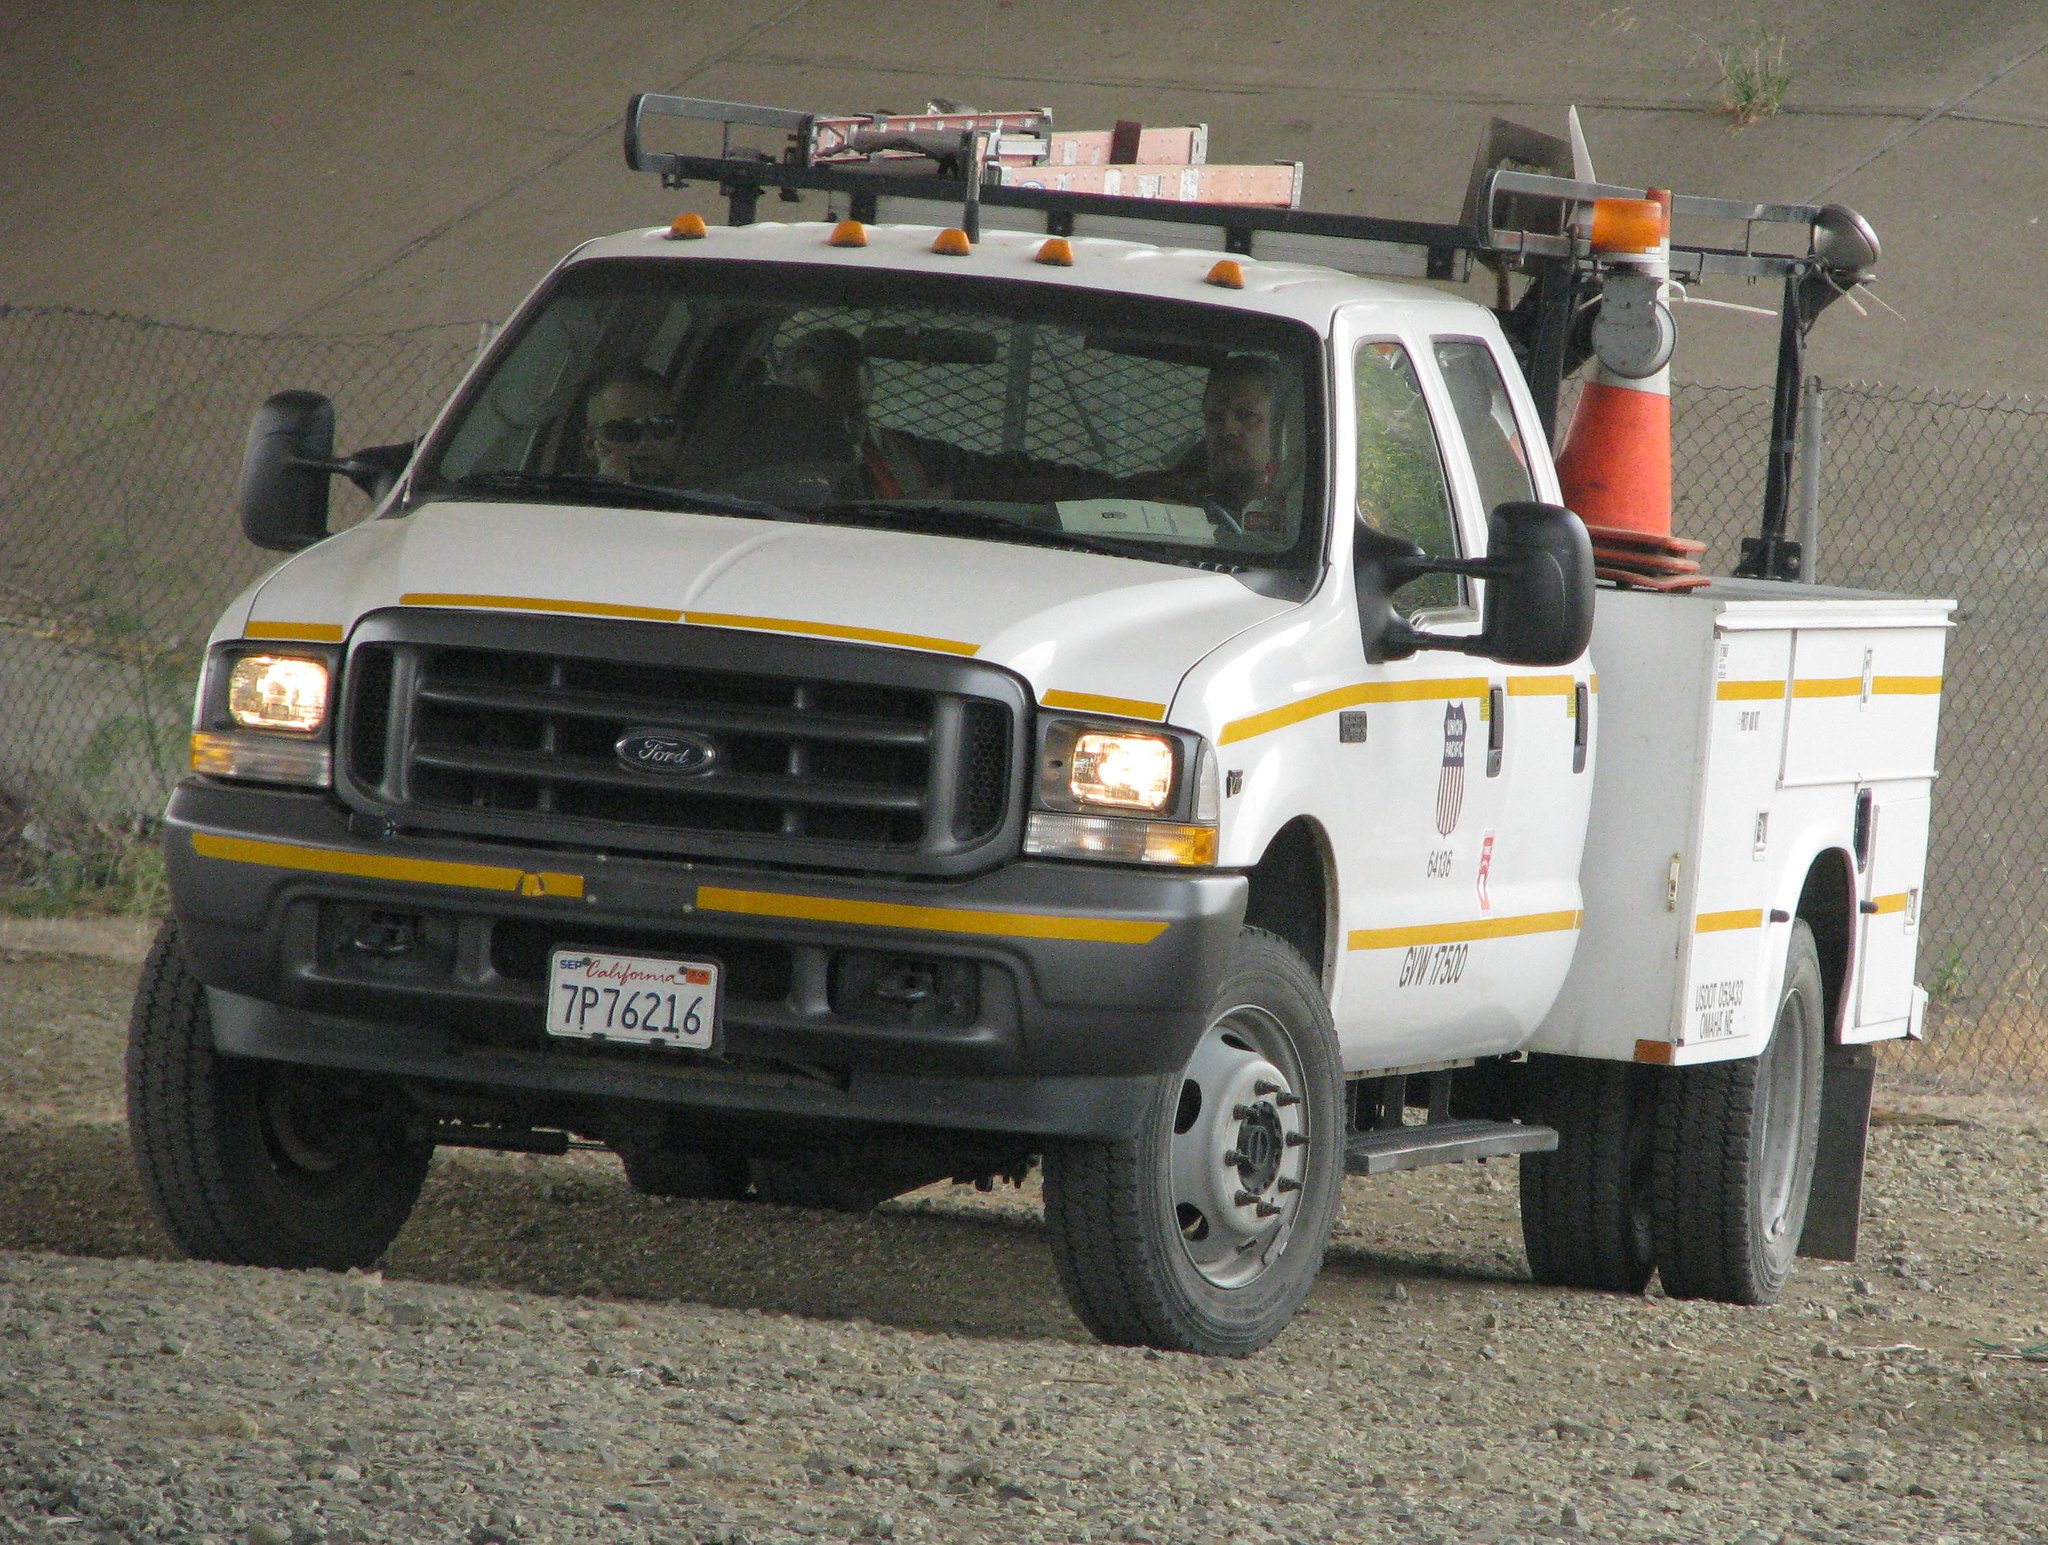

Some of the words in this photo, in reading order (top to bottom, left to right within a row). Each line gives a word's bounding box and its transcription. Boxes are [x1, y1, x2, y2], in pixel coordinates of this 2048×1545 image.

[1447, 718, 1463, 737] UNION
[638, 739, 690, 763] Ford
[1445, 740, 1463, 758] PACIFIC
[1427, 850, 1453, 878] 64136
[560, 959, 582, 969] SEP
[586, 959, 685, 986] California
[1399, 946, 1433, 987] GVW
[1429, 944, 1467, 985] 17500
[561, 984, 704, 1035] 7P76216
[1695, 983, 1717, 1011] USDOT
[1699, 1011, 1724, 1040] OMAHA
